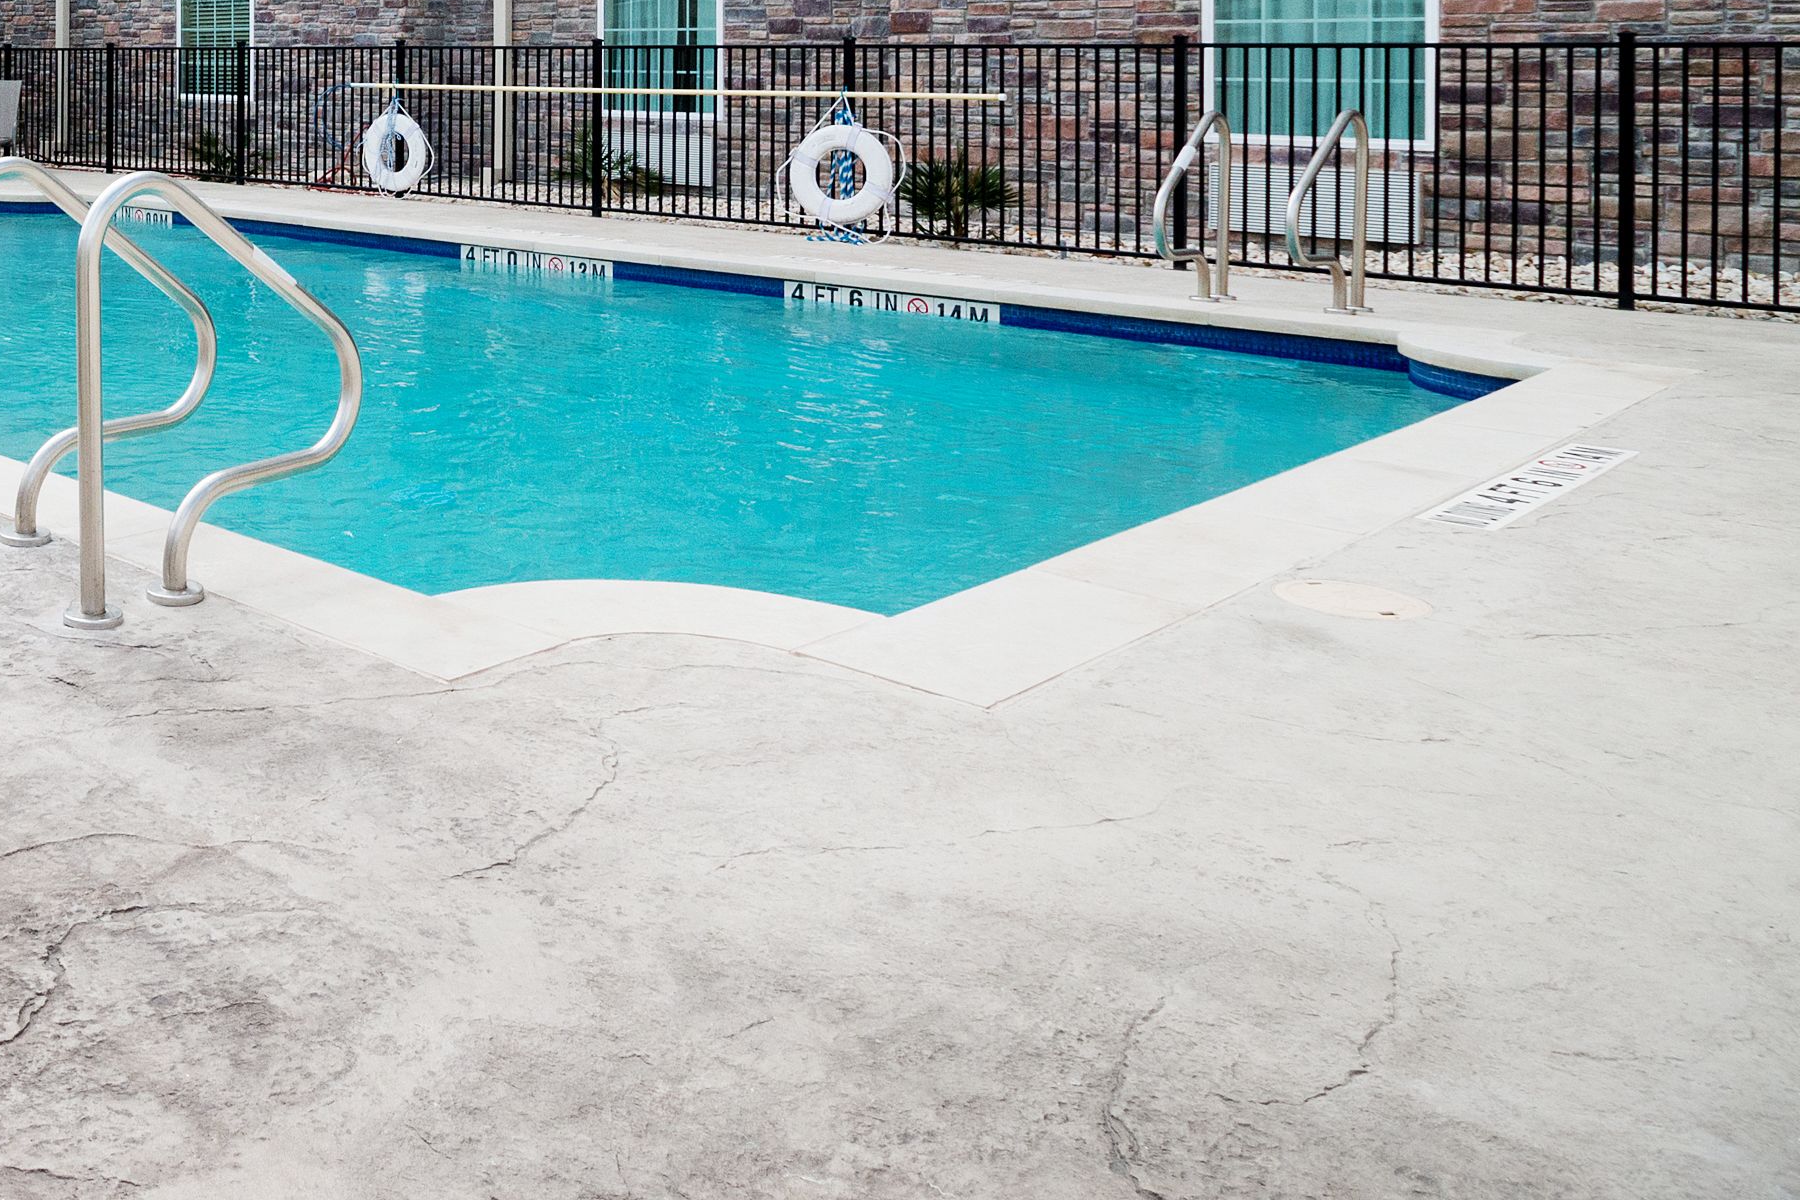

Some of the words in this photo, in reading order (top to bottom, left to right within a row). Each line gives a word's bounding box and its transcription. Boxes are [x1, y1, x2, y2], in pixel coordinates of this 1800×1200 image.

[466, 246, 475, 260] 4
[483, 248, 500, 263] FT
[527, 252, 541, 269] IN
[792, 283, 805, 300] 4
[815, 285, 839, 304] FT
[850, 289, 863, 307] 6
[876, 292, 897, 311] IN
[1477, 494, 1530, 504] 4
[1511, 477, 1563, 487] 6
